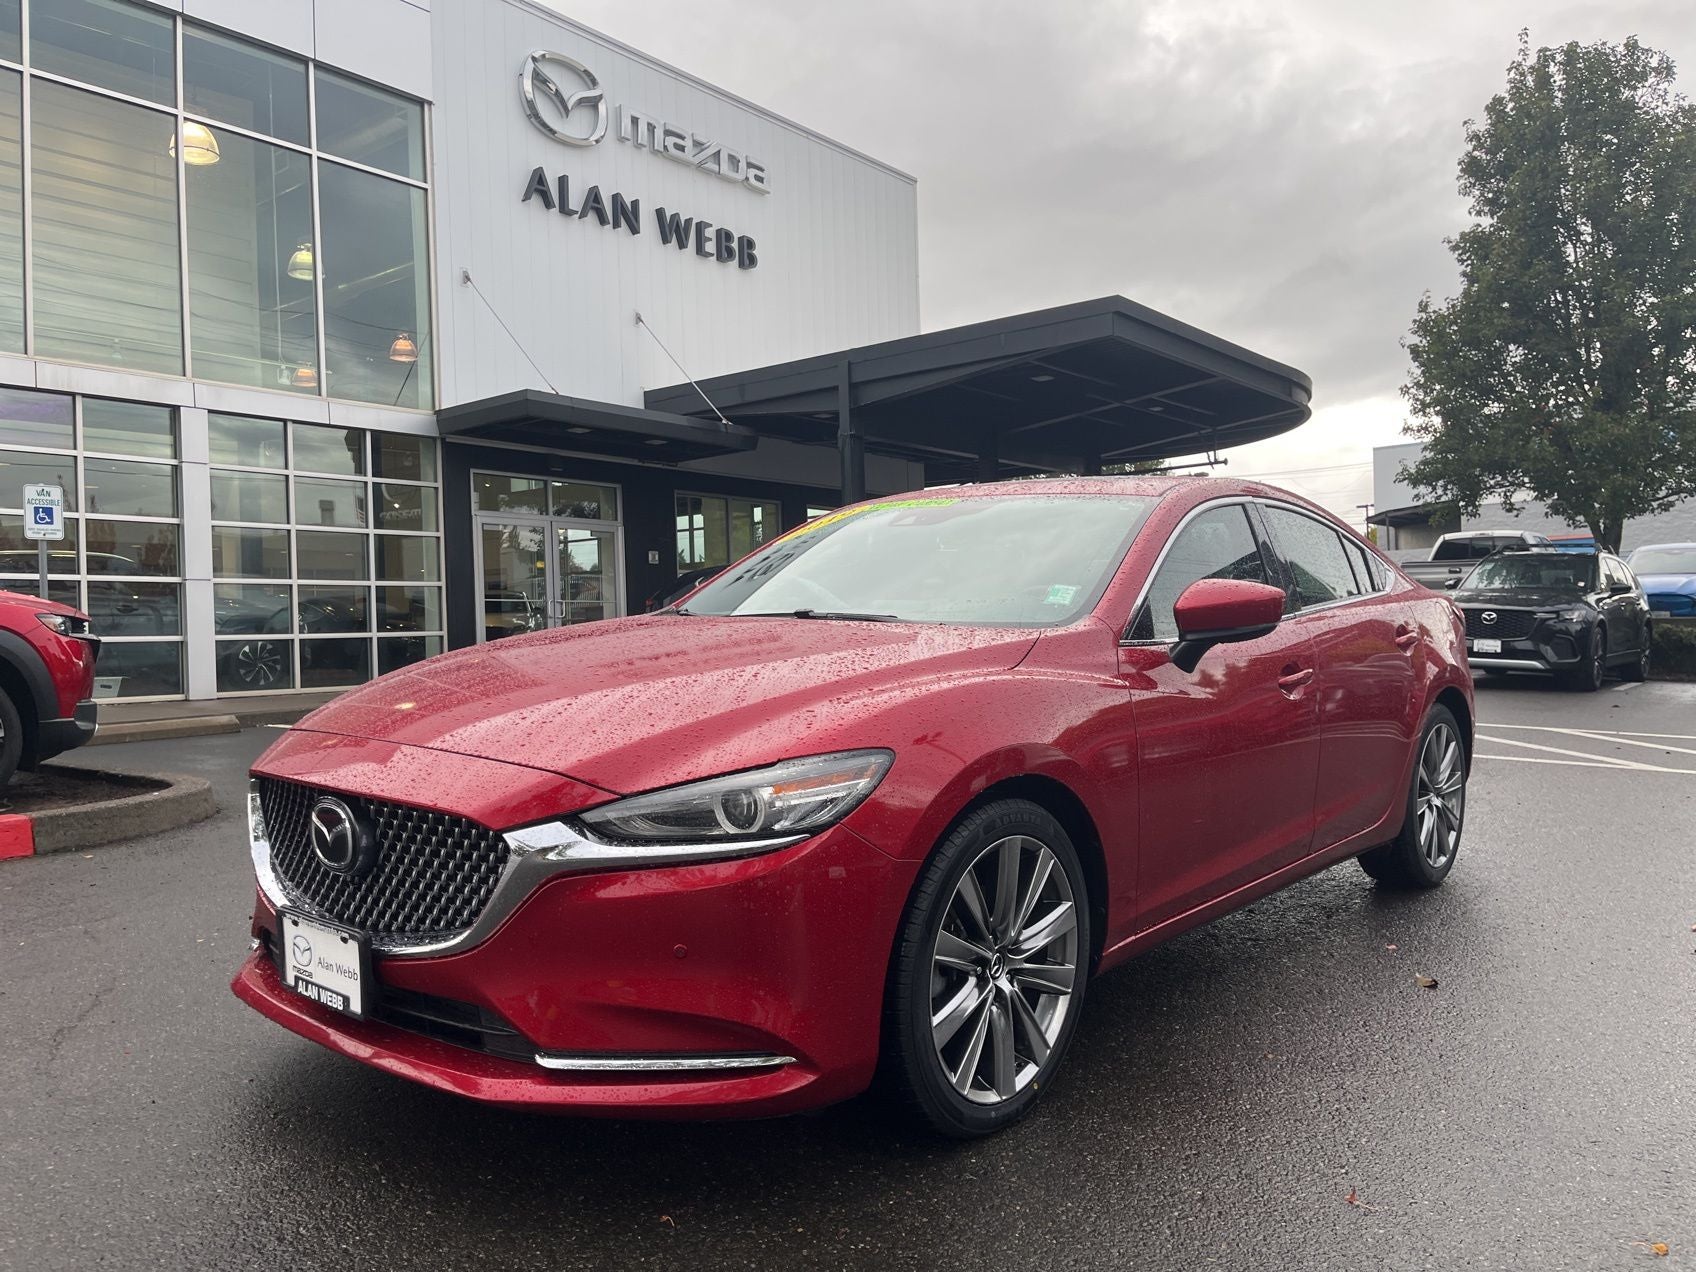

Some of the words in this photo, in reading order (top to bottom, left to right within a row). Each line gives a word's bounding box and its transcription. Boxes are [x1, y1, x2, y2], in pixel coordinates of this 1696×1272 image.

[616, 103, 771, 195] mazda
[521, 166, 641, 236] ALAN
[655, 206, 758, 270] WEBB
[27, 498, 61, 506] ACCESSIBLE
[292, 965, 313, 979] mazda
[317, 957, 334, 973] Alan
[335, 964, 358, 981] Webb
[297, 980, 319, 1001] ALAN
[320, 988, 344, 1010] WEBB
